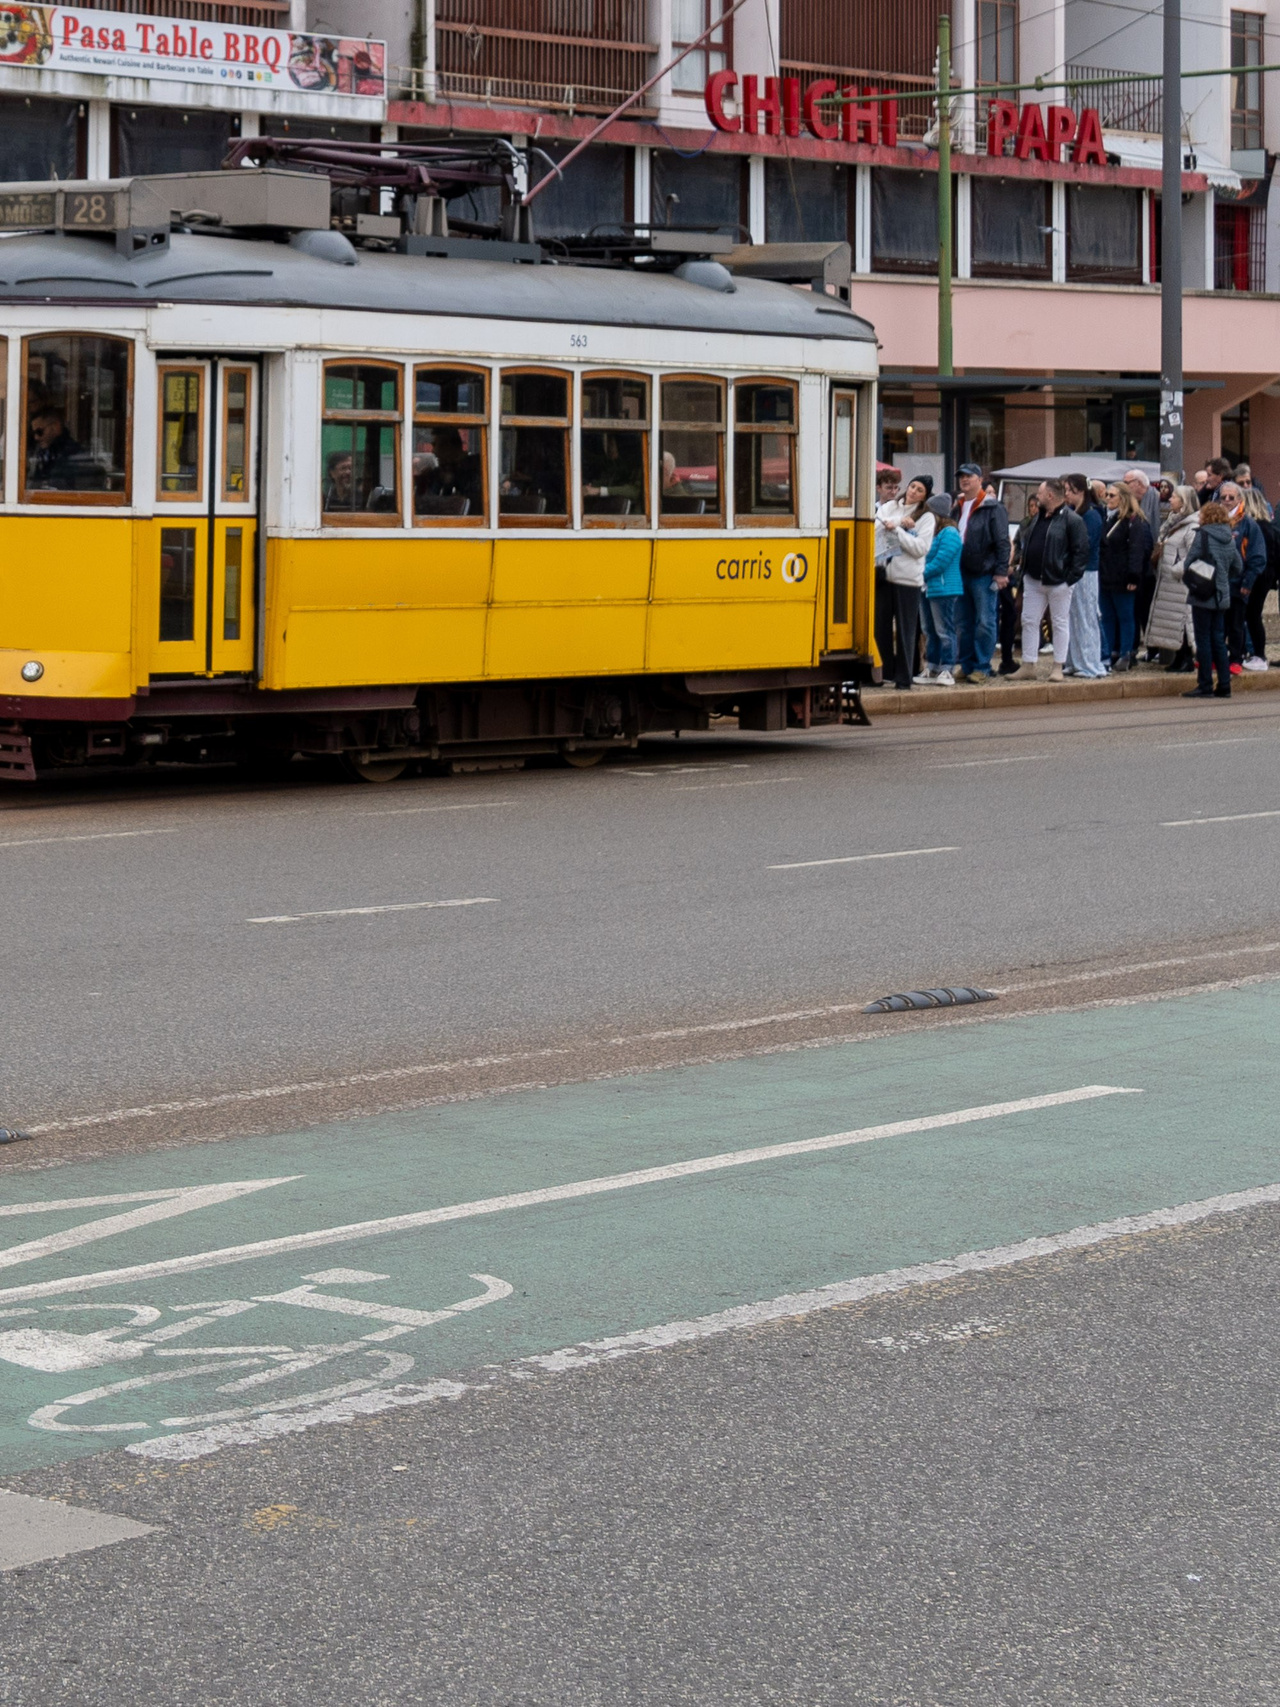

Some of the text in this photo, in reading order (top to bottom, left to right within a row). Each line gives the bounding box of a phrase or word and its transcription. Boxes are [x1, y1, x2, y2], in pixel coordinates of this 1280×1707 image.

[61, 15, 281, 74] Pasa Table BBQ
[60, 53, 91, 63] Authentic
[93, 56, 115, 66] Newari
[117, 58, 141, 68] Cuisine
[142, 60, 154, 69] and
[156, 62, 186, 72] Barbecue
[197, 66, 214, 75] Table
[704, 69, 1108, 166] CHICHI PAPA
[74, 195, 107, 224] 28
[570, 334, 588, 347] 563
[716, 550, 772, 580] carris
